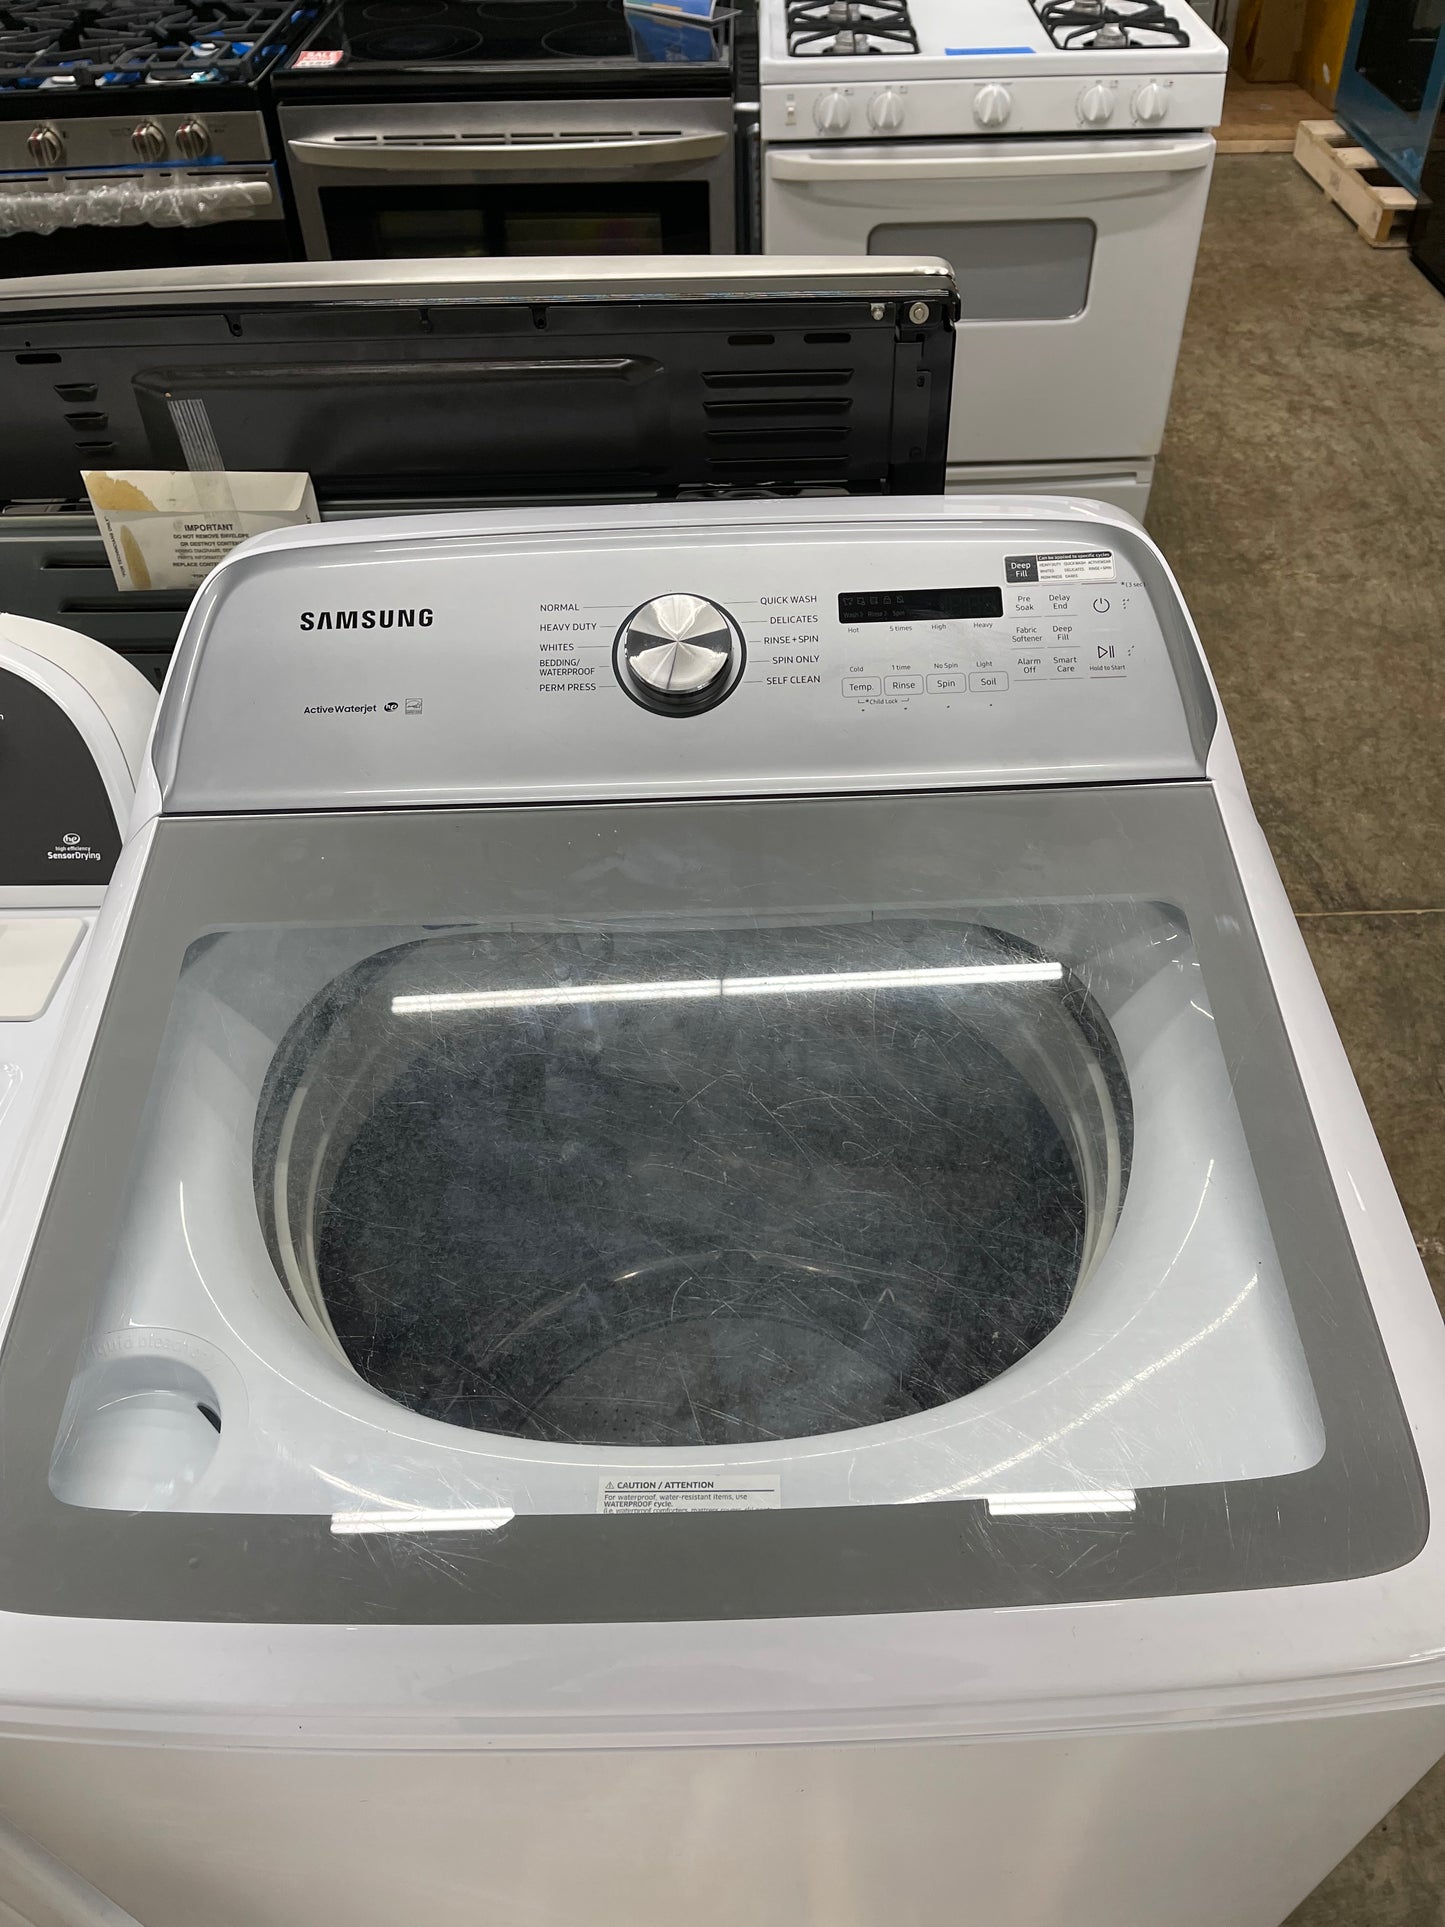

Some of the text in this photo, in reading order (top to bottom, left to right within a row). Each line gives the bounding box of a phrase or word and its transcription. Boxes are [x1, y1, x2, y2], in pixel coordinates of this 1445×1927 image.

[184, 523, 234, 532] IMPORTANT
[1011, 562, 1030, 570] Deep
[760, 595, 817, 605] QUICK WASH
[1049, 594, 1070, 602] Delay
[540, 604, 579, 612] NORMAL
[300, 608, 433, 630] SAMSUNG
[770, 616, 818, 624] DELICATES
[540, 623, 597, 632] HEAVY DUTY
[764, 636, 790, 644] RINSE
[799, 635, 819, 643] SPIN
[540, 643, 574, 652] WHITES
[540, 659, 580, 667] BEDDING/
[772, 655, 820, 664] SPIN ONLY
[540, 668, 596, 676] WATERPROOF
[766, 675, 821, 685] SELF CLEAN
[937, 680, 955, 688] Spin
[540, 683, 596, 692] PERM PRESS
[850, 683, 874, 692] Temp.
[892, 681, 915, 689] Rinse
[48, 852, 101, 860] SensorDrying
[618, 1494, 657, 1502] waterproof,
